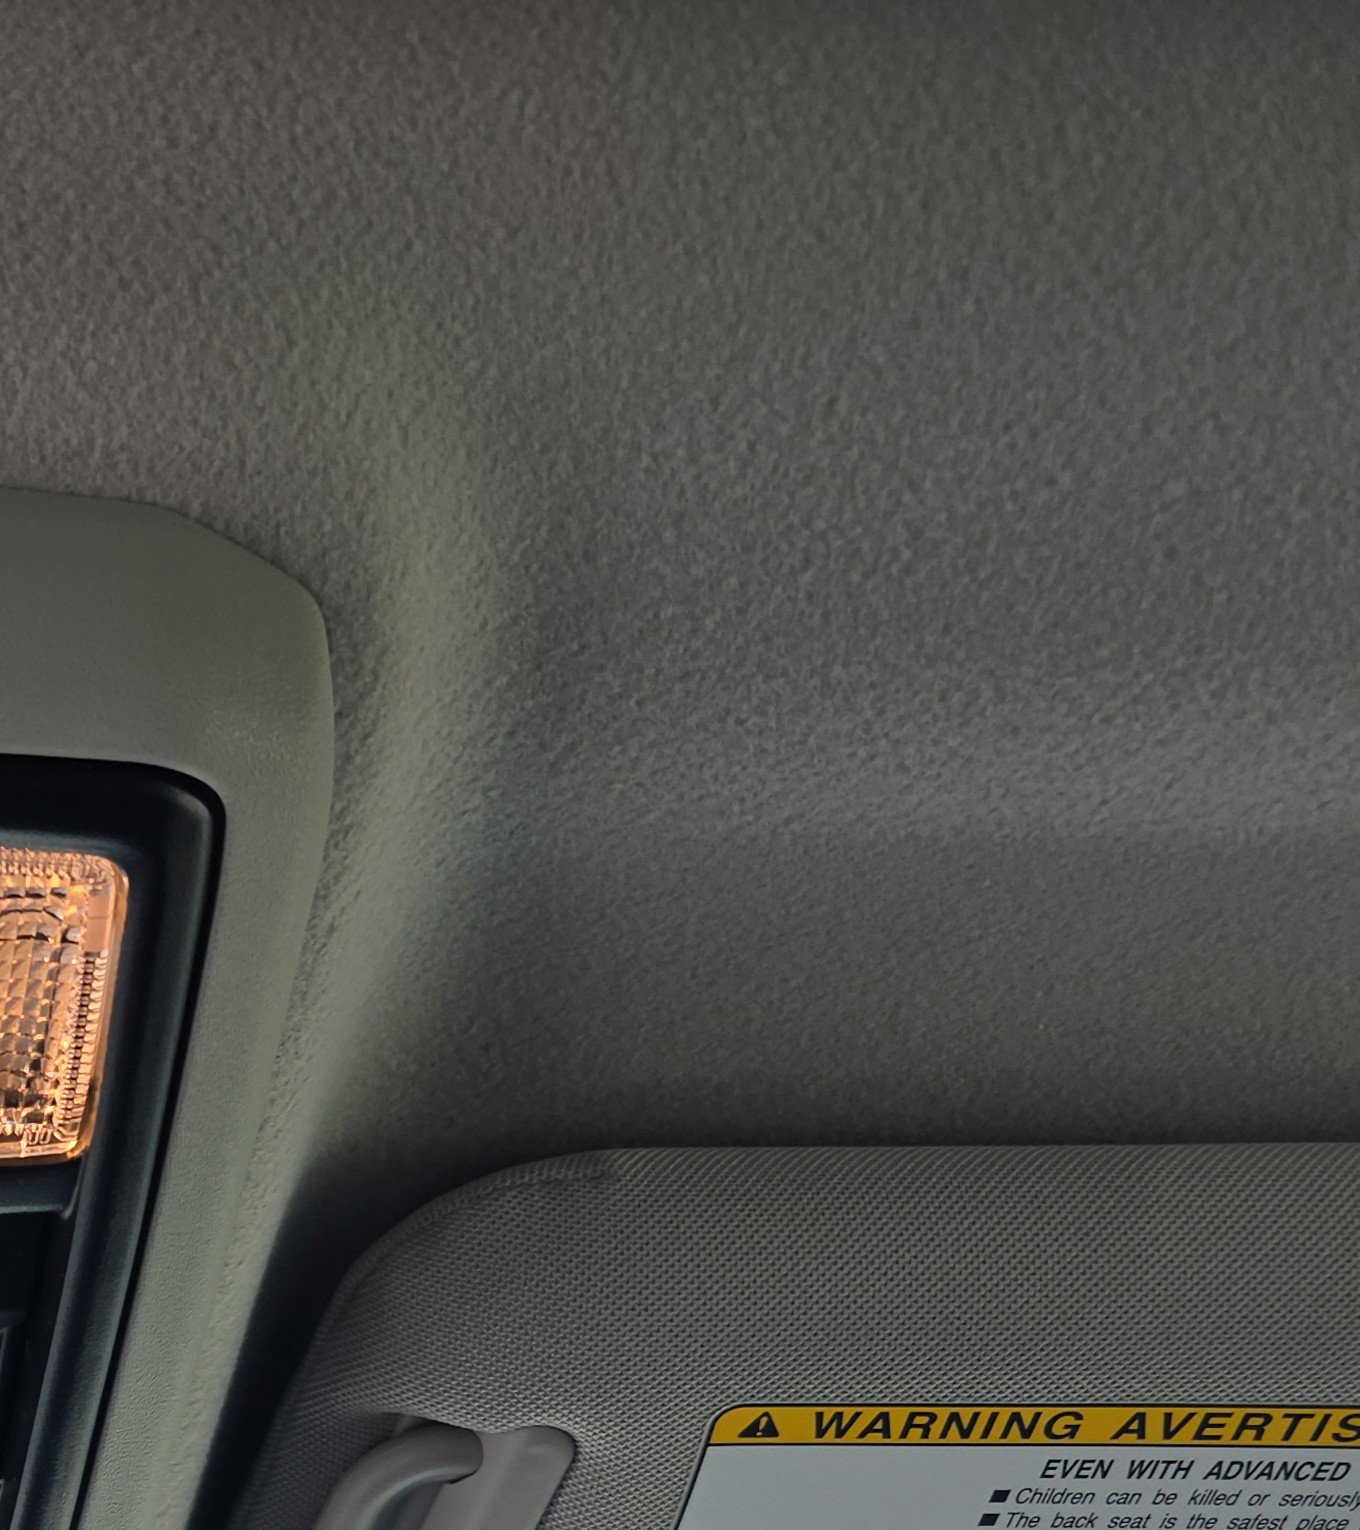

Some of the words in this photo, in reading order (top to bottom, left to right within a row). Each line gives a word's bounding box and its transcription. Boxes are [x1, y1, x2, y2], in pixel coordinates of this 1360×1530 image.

[815, 1411, 1083, 1440] WARNING
[1040, 1460, 1114, 1479] EVEN
[1127, 1460, 1195, 1479] WITH
[1203, 1461, 1351, 1481] ADVANCED
[1016, 1488, 1095, 1504] Children
[1106, 1493, 1142, 1505] can
[1152, 1489, 1177, 1505] be
[1187, 1489, 1238, 1506] killed
[1248, 1494, 1271, 1506] or
[1007, 1512, 1040, 1528] The
[1050, 1512, 1098, 1528] back
[1107, 1514, 1151, 1528] seat
[1159, 1513, 1177, 1529] is
[1187, 1514, 1217, 1529] the
[1227, 1514, 1288, 1530] safest
